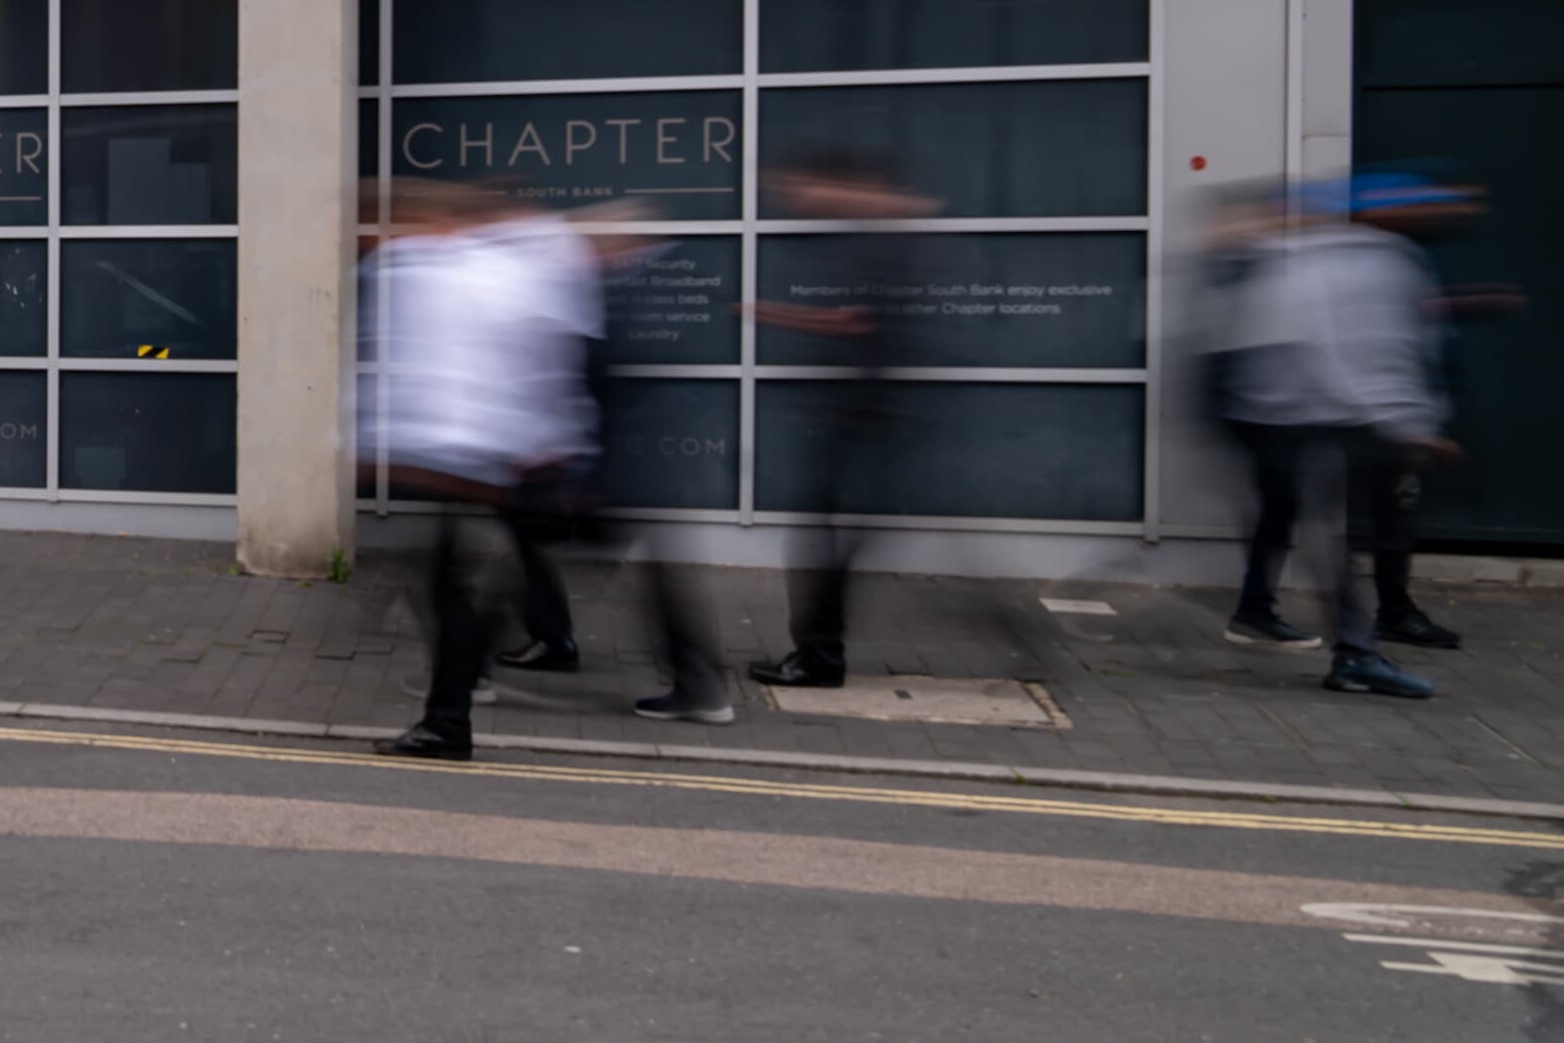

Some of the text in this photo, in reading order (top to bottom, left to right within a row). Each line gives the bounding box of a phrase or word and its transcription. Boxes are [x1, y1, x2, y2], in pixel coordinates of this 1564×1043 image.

[403, 116, 736, 169] CHAPTER
[516, 186, 614, 199] SOUTH BANK
[650, 275, 722, 287] Broadband
[789, 284, 850, 296] Members
[926, 283, 967, 296] South
[969, 283, 1004, 296] Bank
[1007, 284, 1045, 298] enjoy
[1048, 284, 1113, 296] exclusive
[677, 294, 709, 305] beds
[941, 302, 996, 317] Chapter
[998, 302, 1061, 315] locations
[665, 312, 711, 323] service
[628, 329, 680, 342] Laundry
